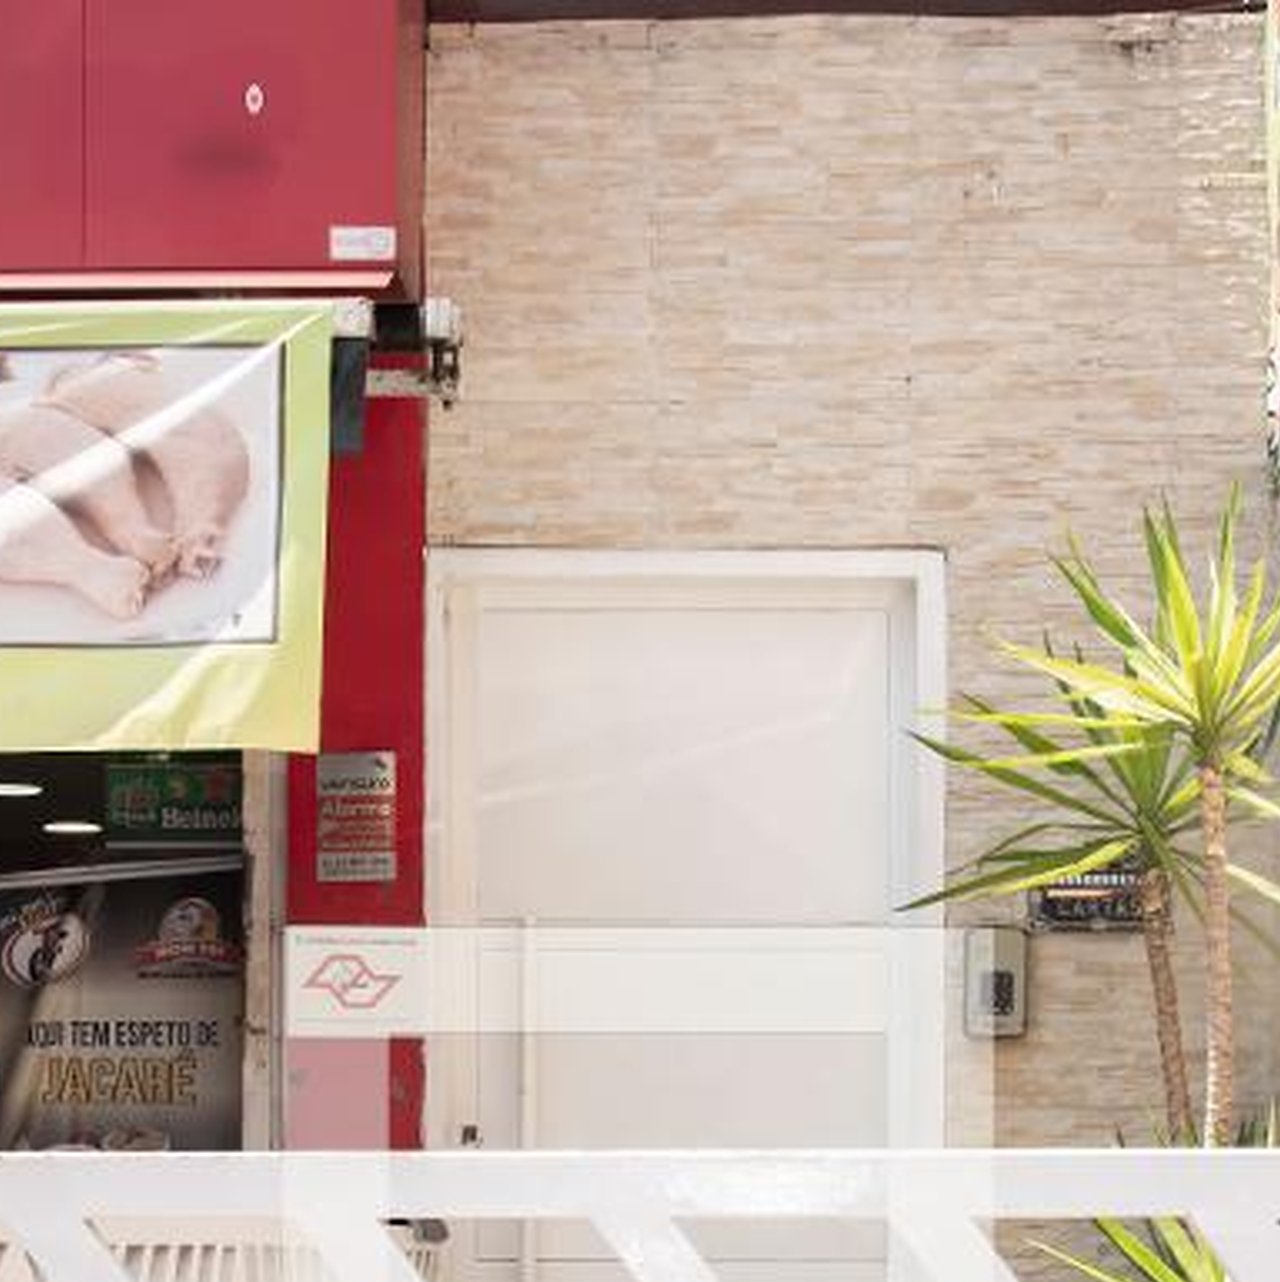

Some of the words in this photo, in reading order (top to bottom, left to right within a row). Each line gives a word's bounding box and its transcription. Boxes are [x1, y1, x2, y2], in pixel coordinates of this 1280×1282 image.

[71, 1020, 111, 1047] TEM
[116, 1020, 191, 1047] ESPETO
[196, 1020, 220, 1047] DE
[42, 1048, 198, 1106] JACARÉ
